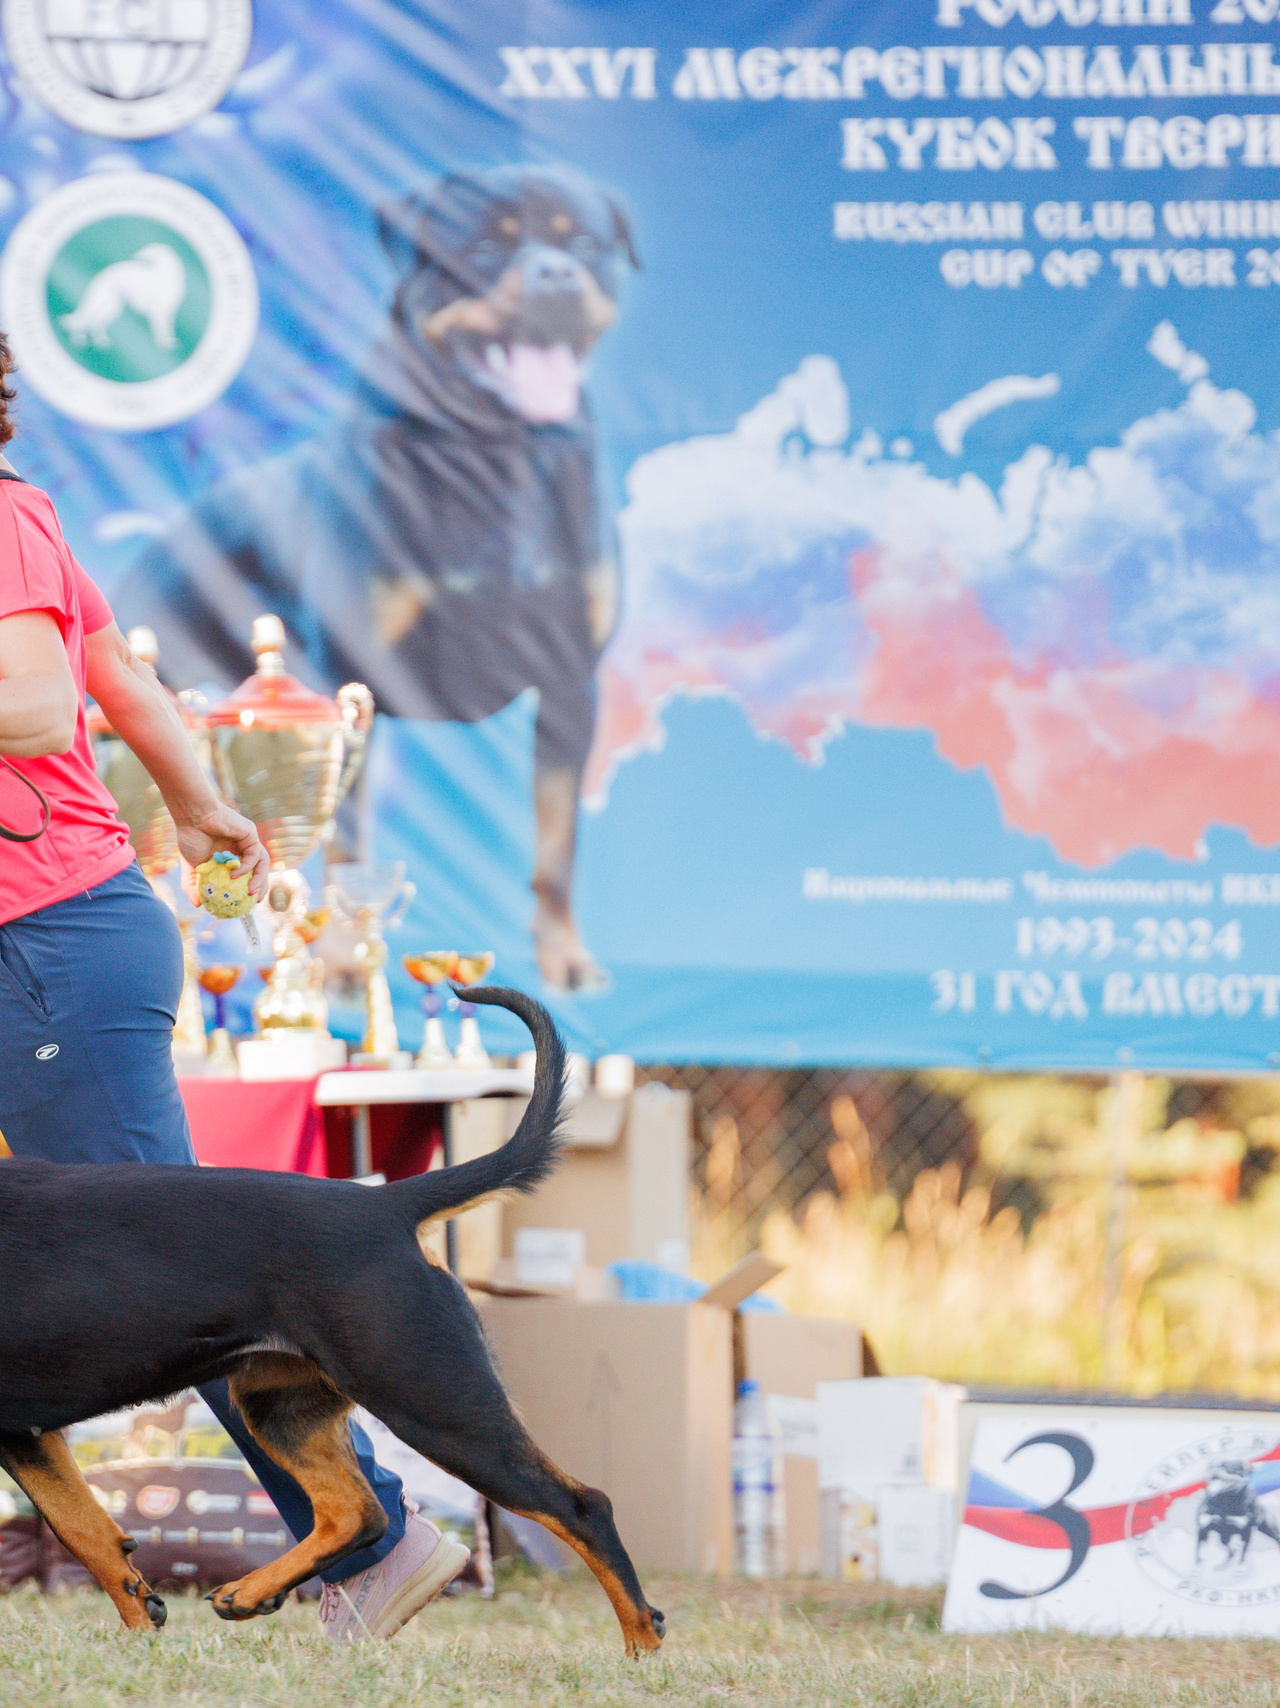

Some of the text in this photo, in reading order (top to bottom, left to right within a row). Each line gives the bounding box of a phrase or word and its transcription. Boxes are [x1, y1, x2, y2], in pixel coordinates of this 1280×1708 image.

[840, 116, 1058, 171] КУБОК
[1016, 915, 1244, 960] 1993-2024
[930, 968, 977, 1016] 31
[992, 969, 1090, 1022] ГОД
[978, 1428, 1096, 1601] 3
